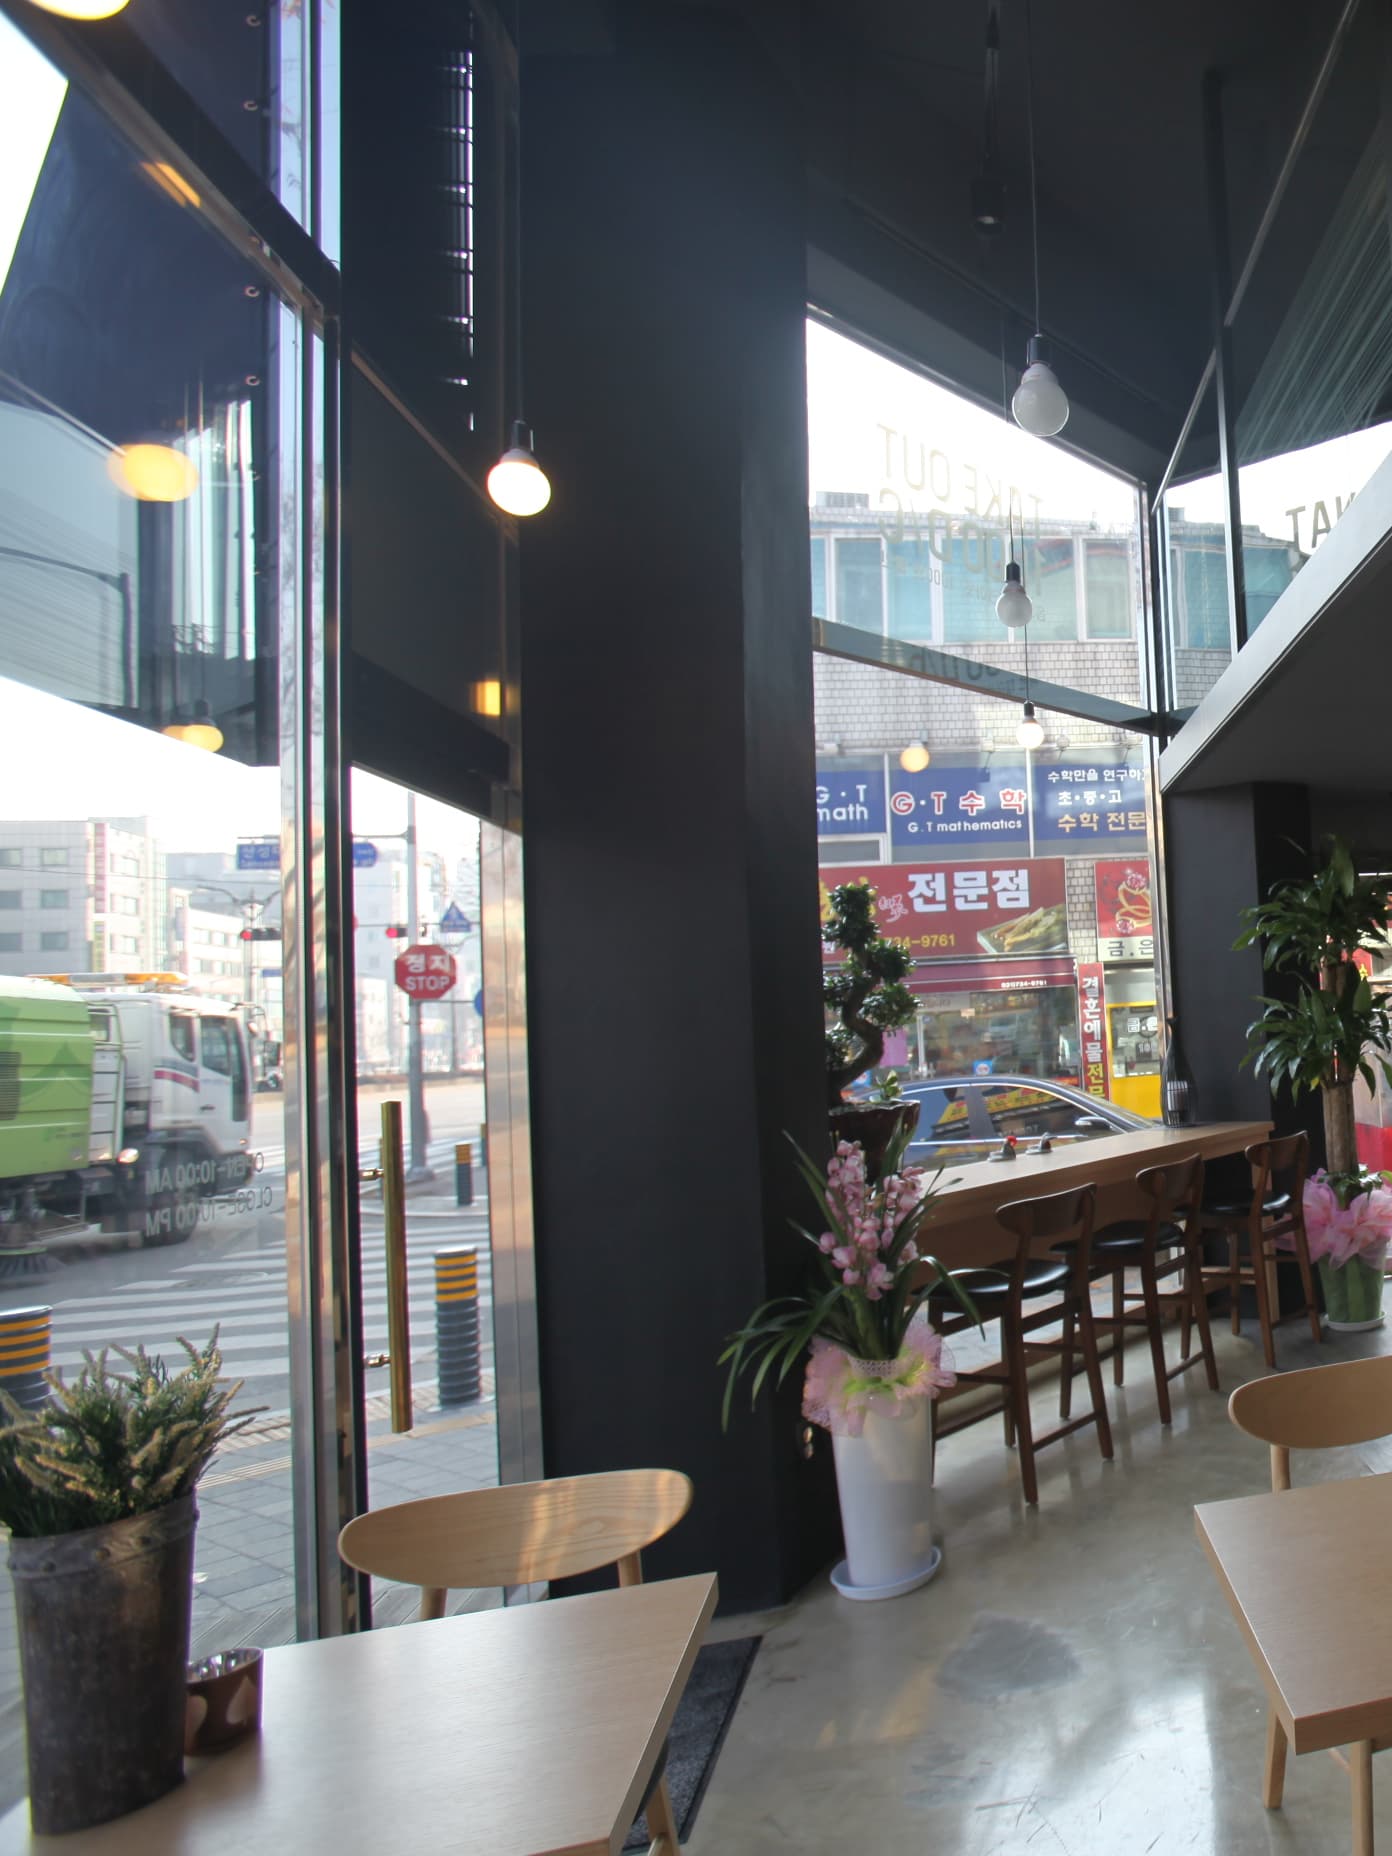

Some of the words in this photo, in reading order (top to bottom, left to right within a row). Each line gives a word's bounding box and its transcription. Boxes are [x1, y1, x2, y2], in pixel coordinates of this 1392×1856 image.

[1048, 768, 1098, 783] 수학만을
[936, 819, 1023, 833] mathematics
[1057, 812, 1099, 833] 수학
[1106, 811, 1146, 831] 전문
[907, 869, 1030, 913] 전문점
[406, 954, 450, 974] 정지
[405, 975, 450, 991] STOP
